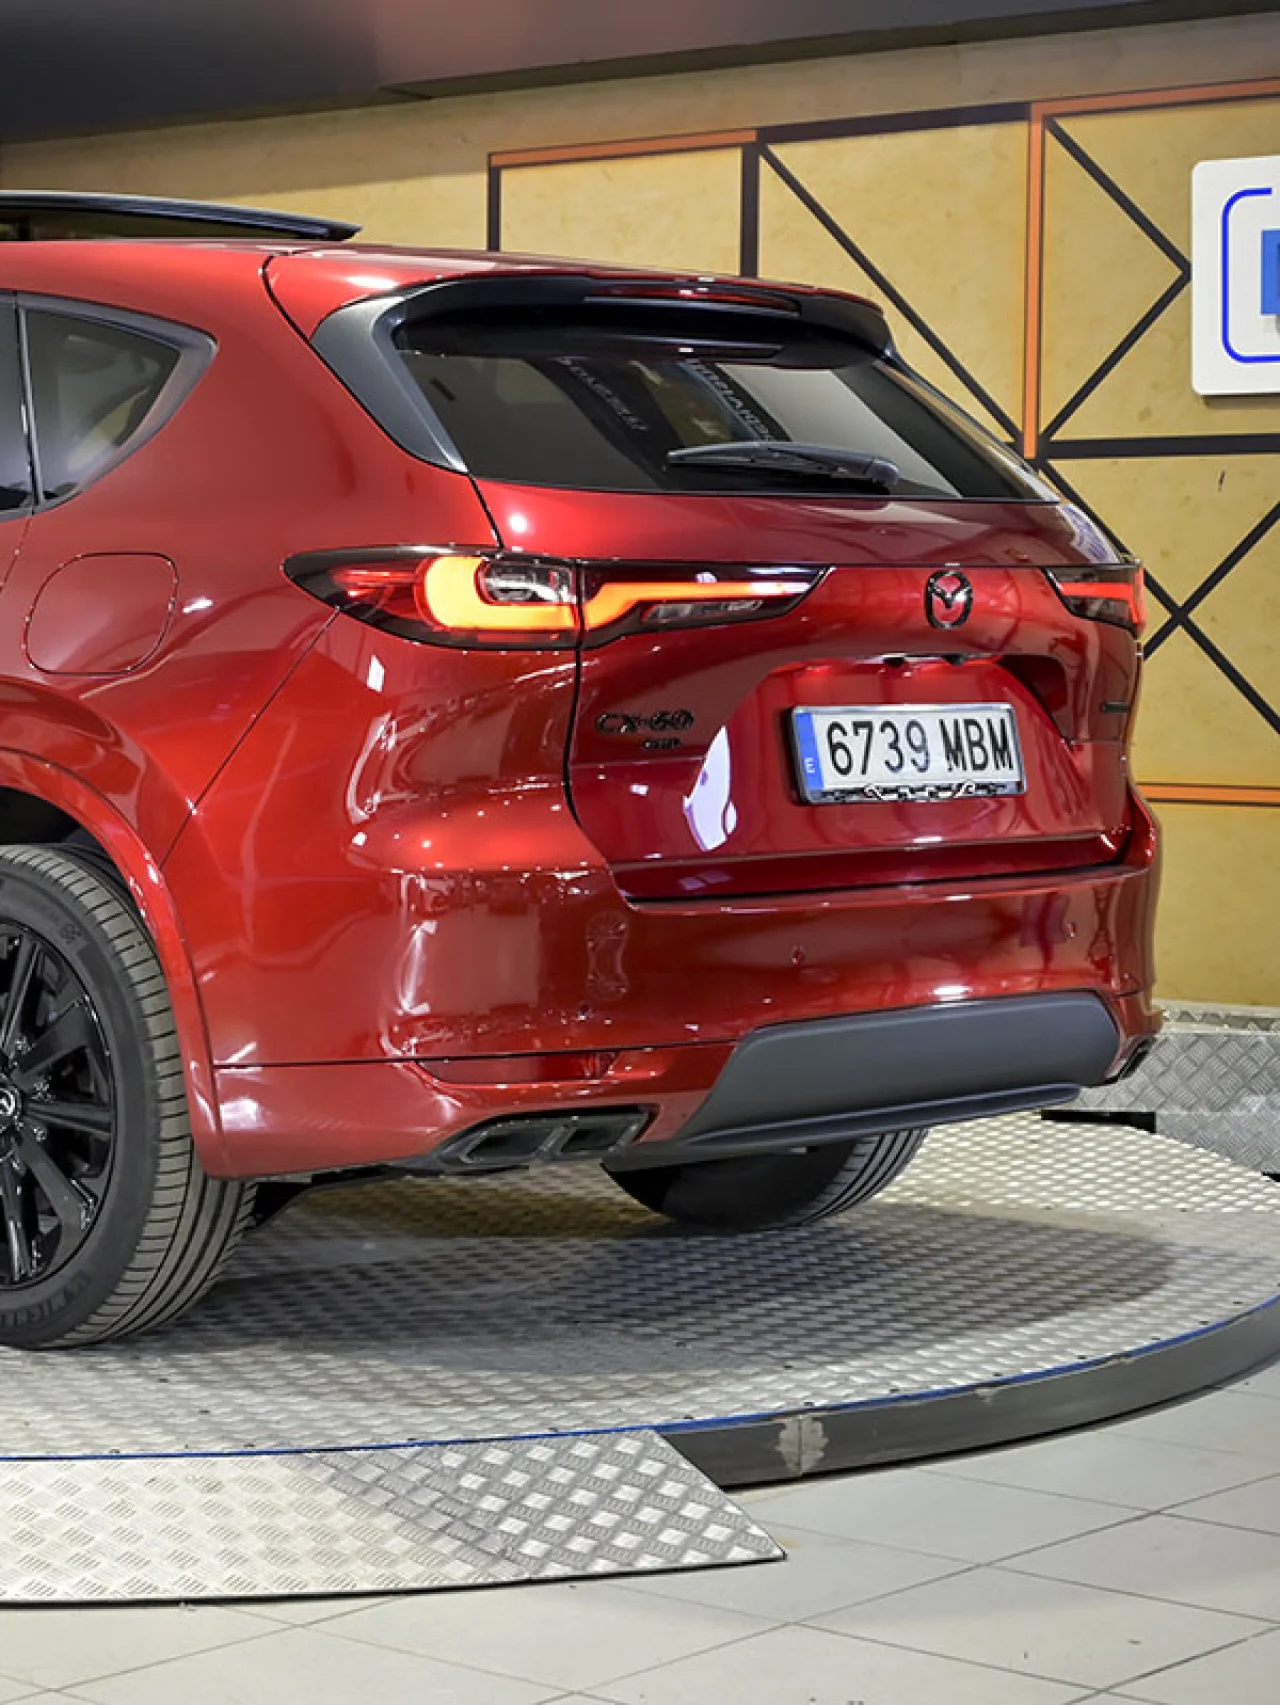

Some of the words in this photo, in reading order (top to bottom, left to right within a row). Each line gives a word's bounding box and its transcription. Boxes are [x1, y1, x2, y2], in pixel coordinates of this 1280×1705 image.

[803, 756, 816, 774] E
[827, 719, 930, 776] 6739
[938, 717, 1014, 773] MBM
